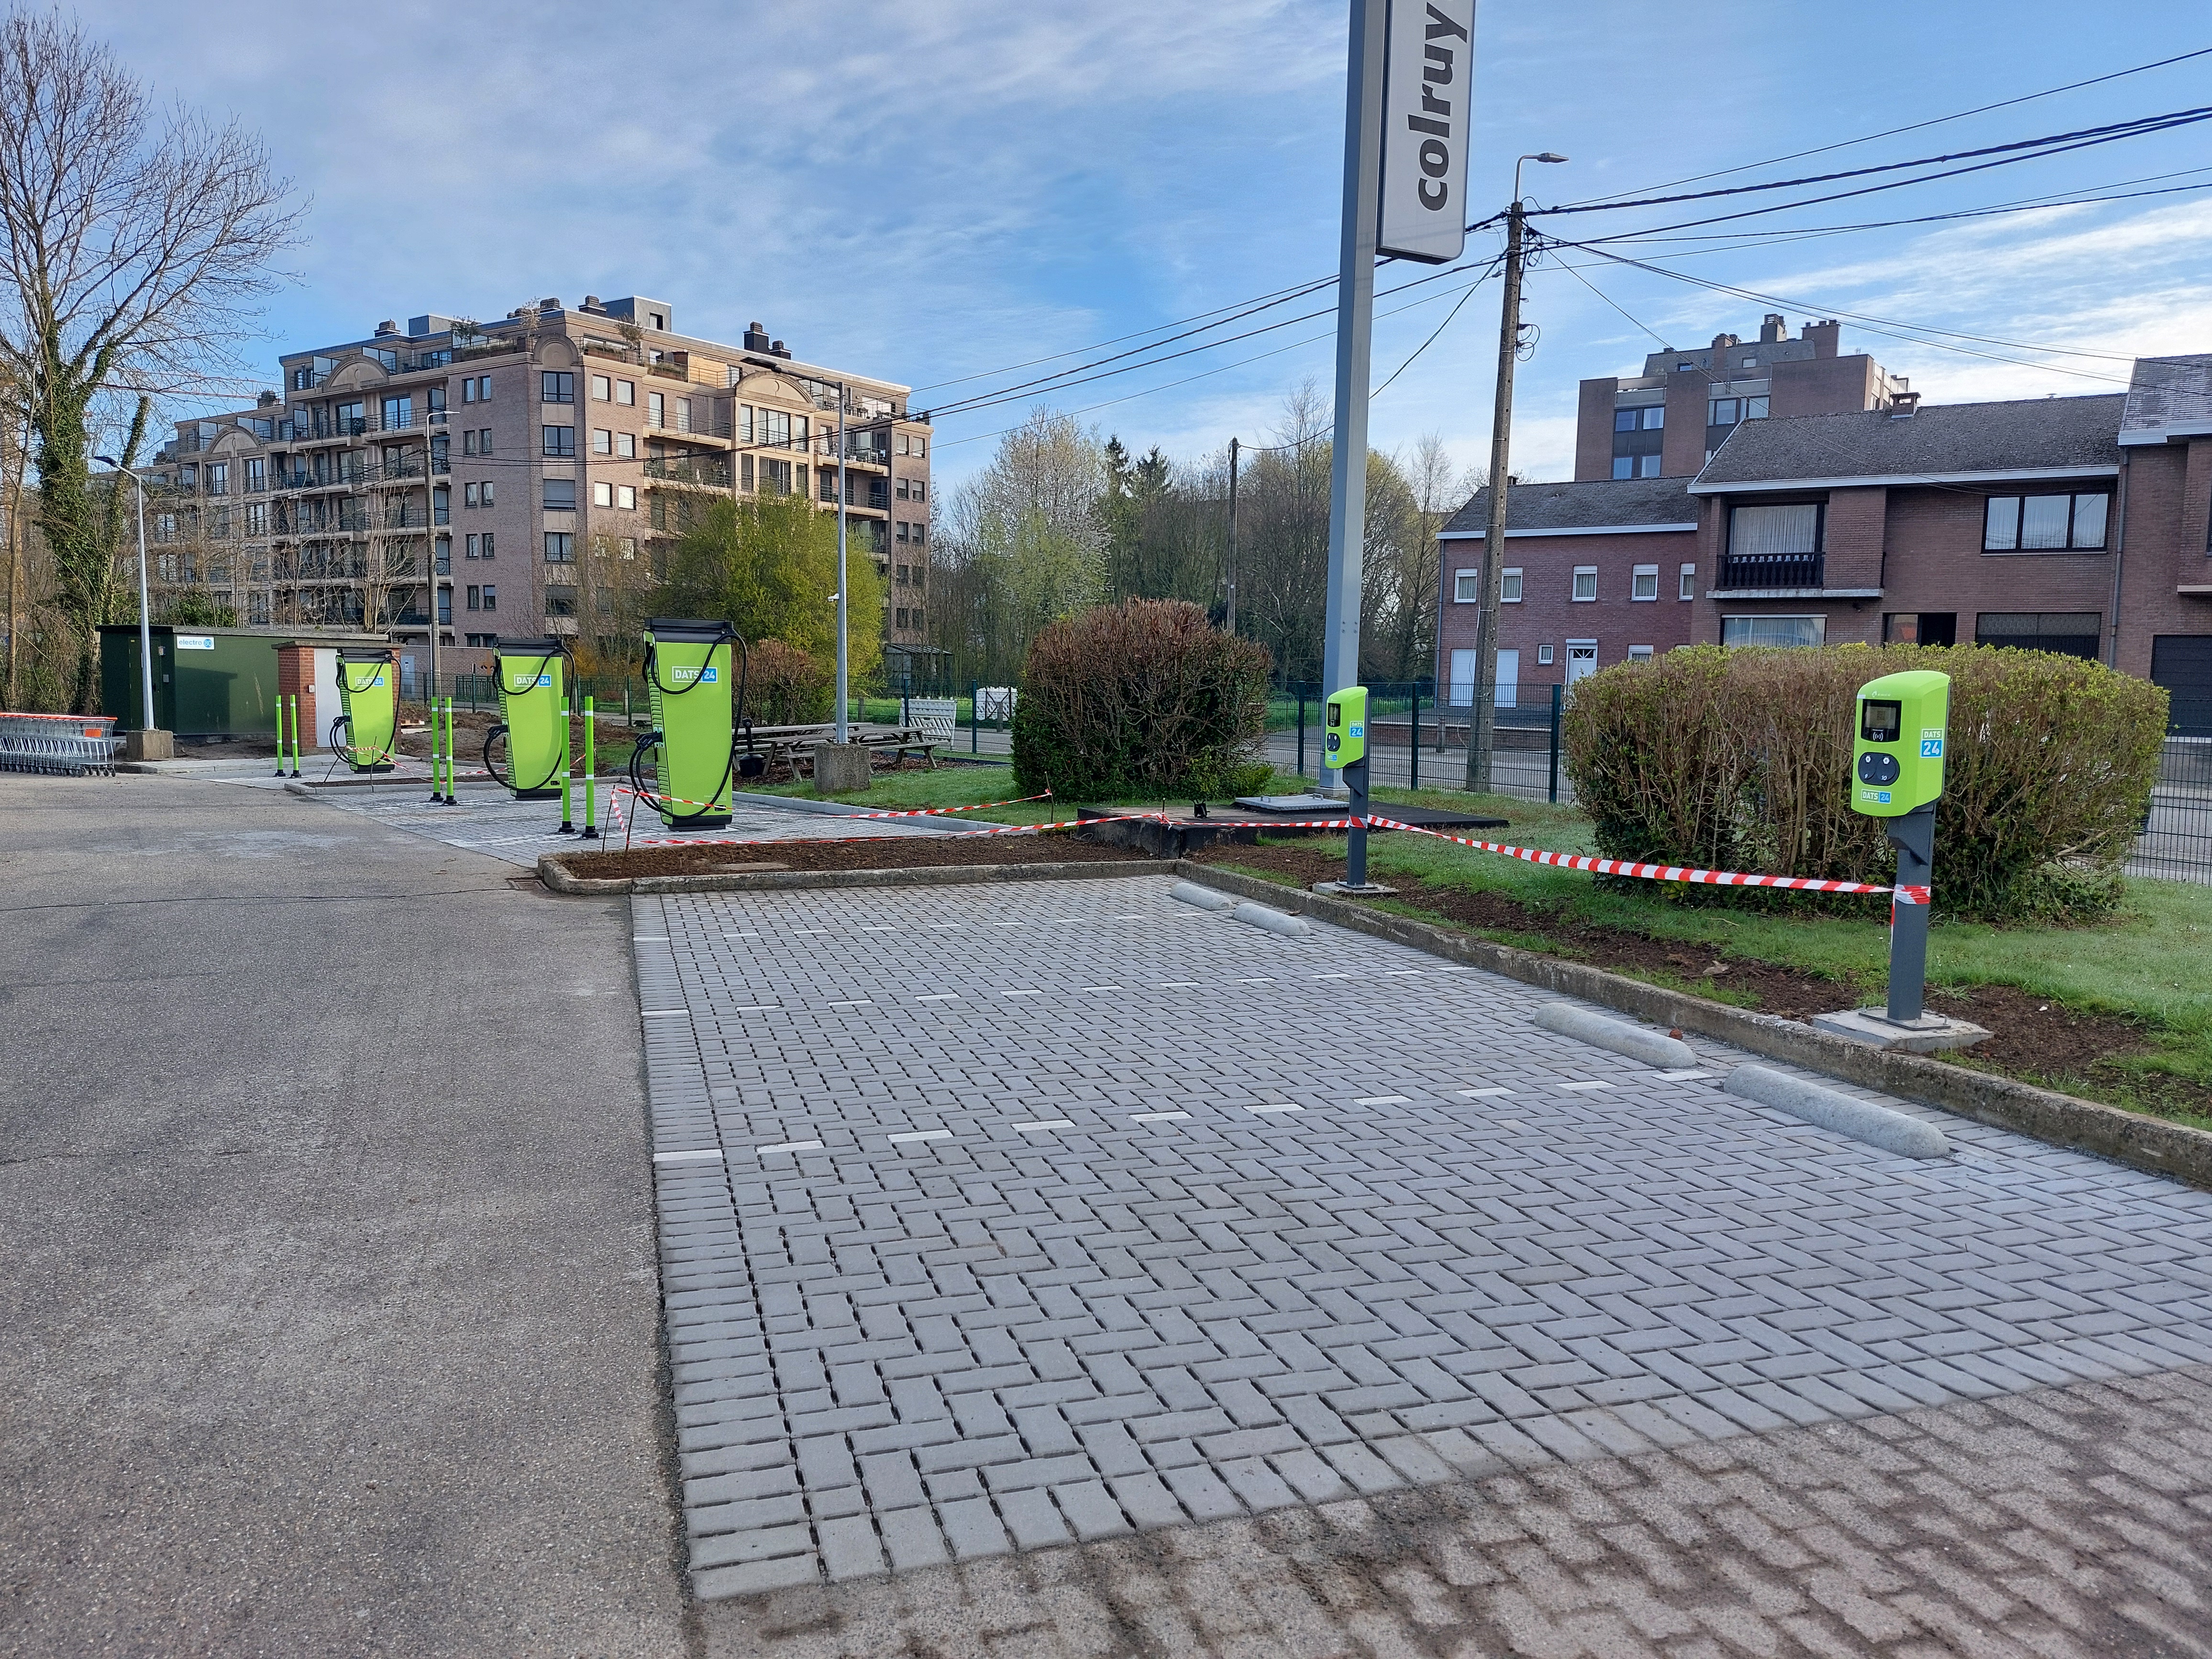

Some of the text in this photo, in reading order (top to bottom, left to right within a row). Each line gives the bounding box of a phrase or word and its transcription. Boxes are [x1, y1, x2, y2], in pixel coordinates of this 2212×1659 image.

[675, 670, 716, 679] DATS 24
[516, 676, 537, 685] DATS
[1351, 728, 1362, 736] 24
[1923, 741, 1940, 755] 24
[1862, 791, 1890, 801] DATS 24
